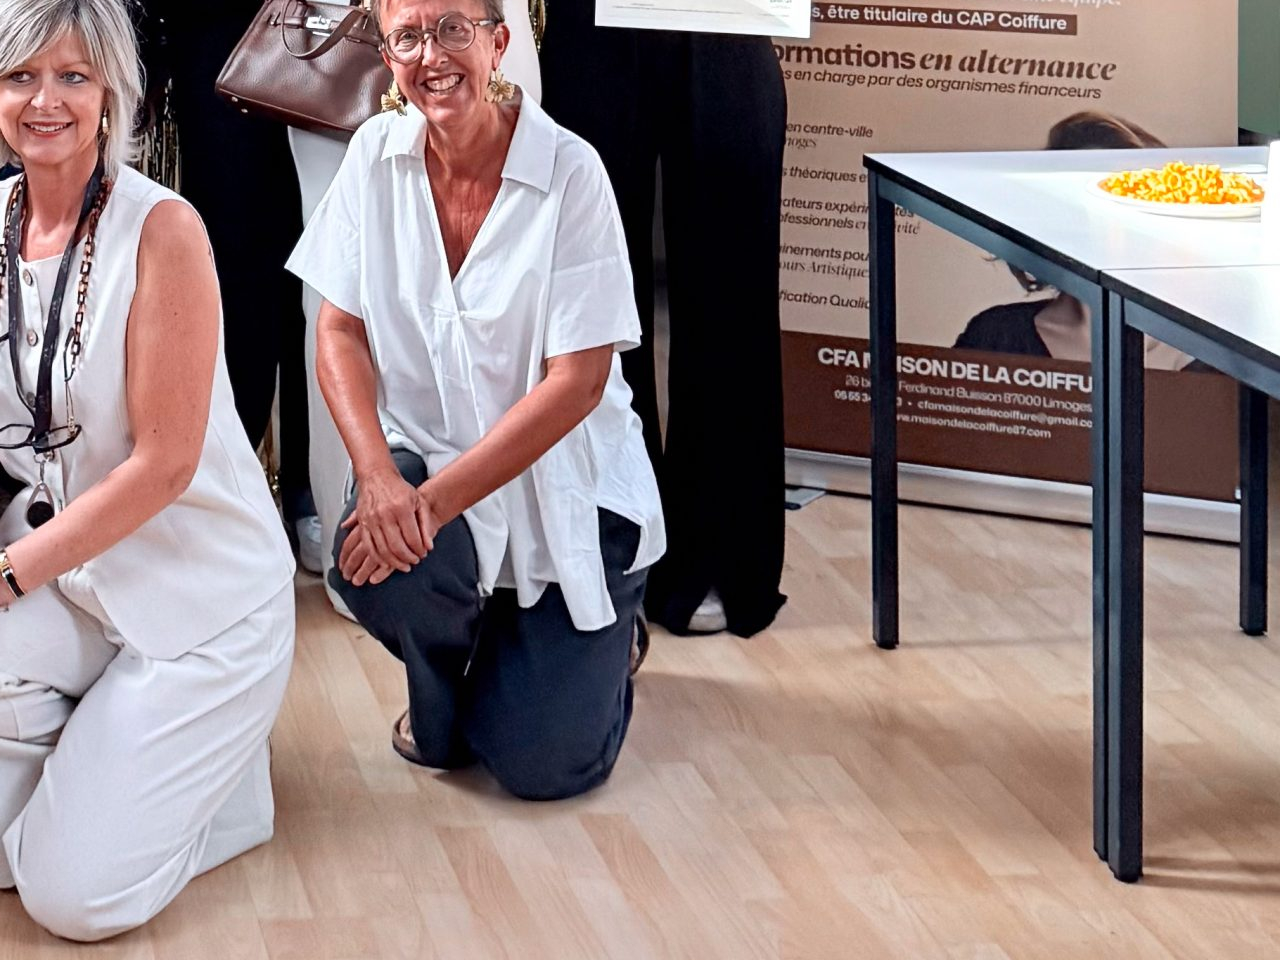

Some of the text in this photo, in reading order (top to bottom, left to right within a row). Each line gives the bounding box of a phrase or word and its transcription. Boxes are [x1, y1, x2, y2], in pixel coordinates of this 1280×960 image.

[827, 4, 860, 19] être
[863, 7, 928, 22] titulaire
[931, 10, 953, 24] du
[956, 11, 995, 26] CAP
[998, 13, 1067, 30] Coiffure
[773, 43, 1117, 80] ormations en alternance
[794, 70, 812, 82] en
[814, 69, 866, 86] charge
[867, 74, 895, 87] par
[896, 74, 923, 88] des
[925, 77, 1016, 93] organismes
[1018, 81, 1102, 99] financeurs
[787, 123, 873, 138] en centre-ville
[790, 166, 857, 182] théoriques
[782, 197, 823, 210] ateurs
[780, 212, 854, 229] ofessionnels
[842, 251, 869, 262] pou
[809, 262, 869, 280] Artistique
[780, 290, 827, 305] fication
[817, 347, 860, 368] CFA
[951, 361, 980, 381] DE
[983, 364, 1011, 384] LA
[1013, 368, 1092, 393] COIFFU
[899, 380, 955, 397] Ferdinand
[1043, 396, 1093, 413] Limoges
[917, 400, 1093, 428] cfamaisondelacoiffure@gmail.co
